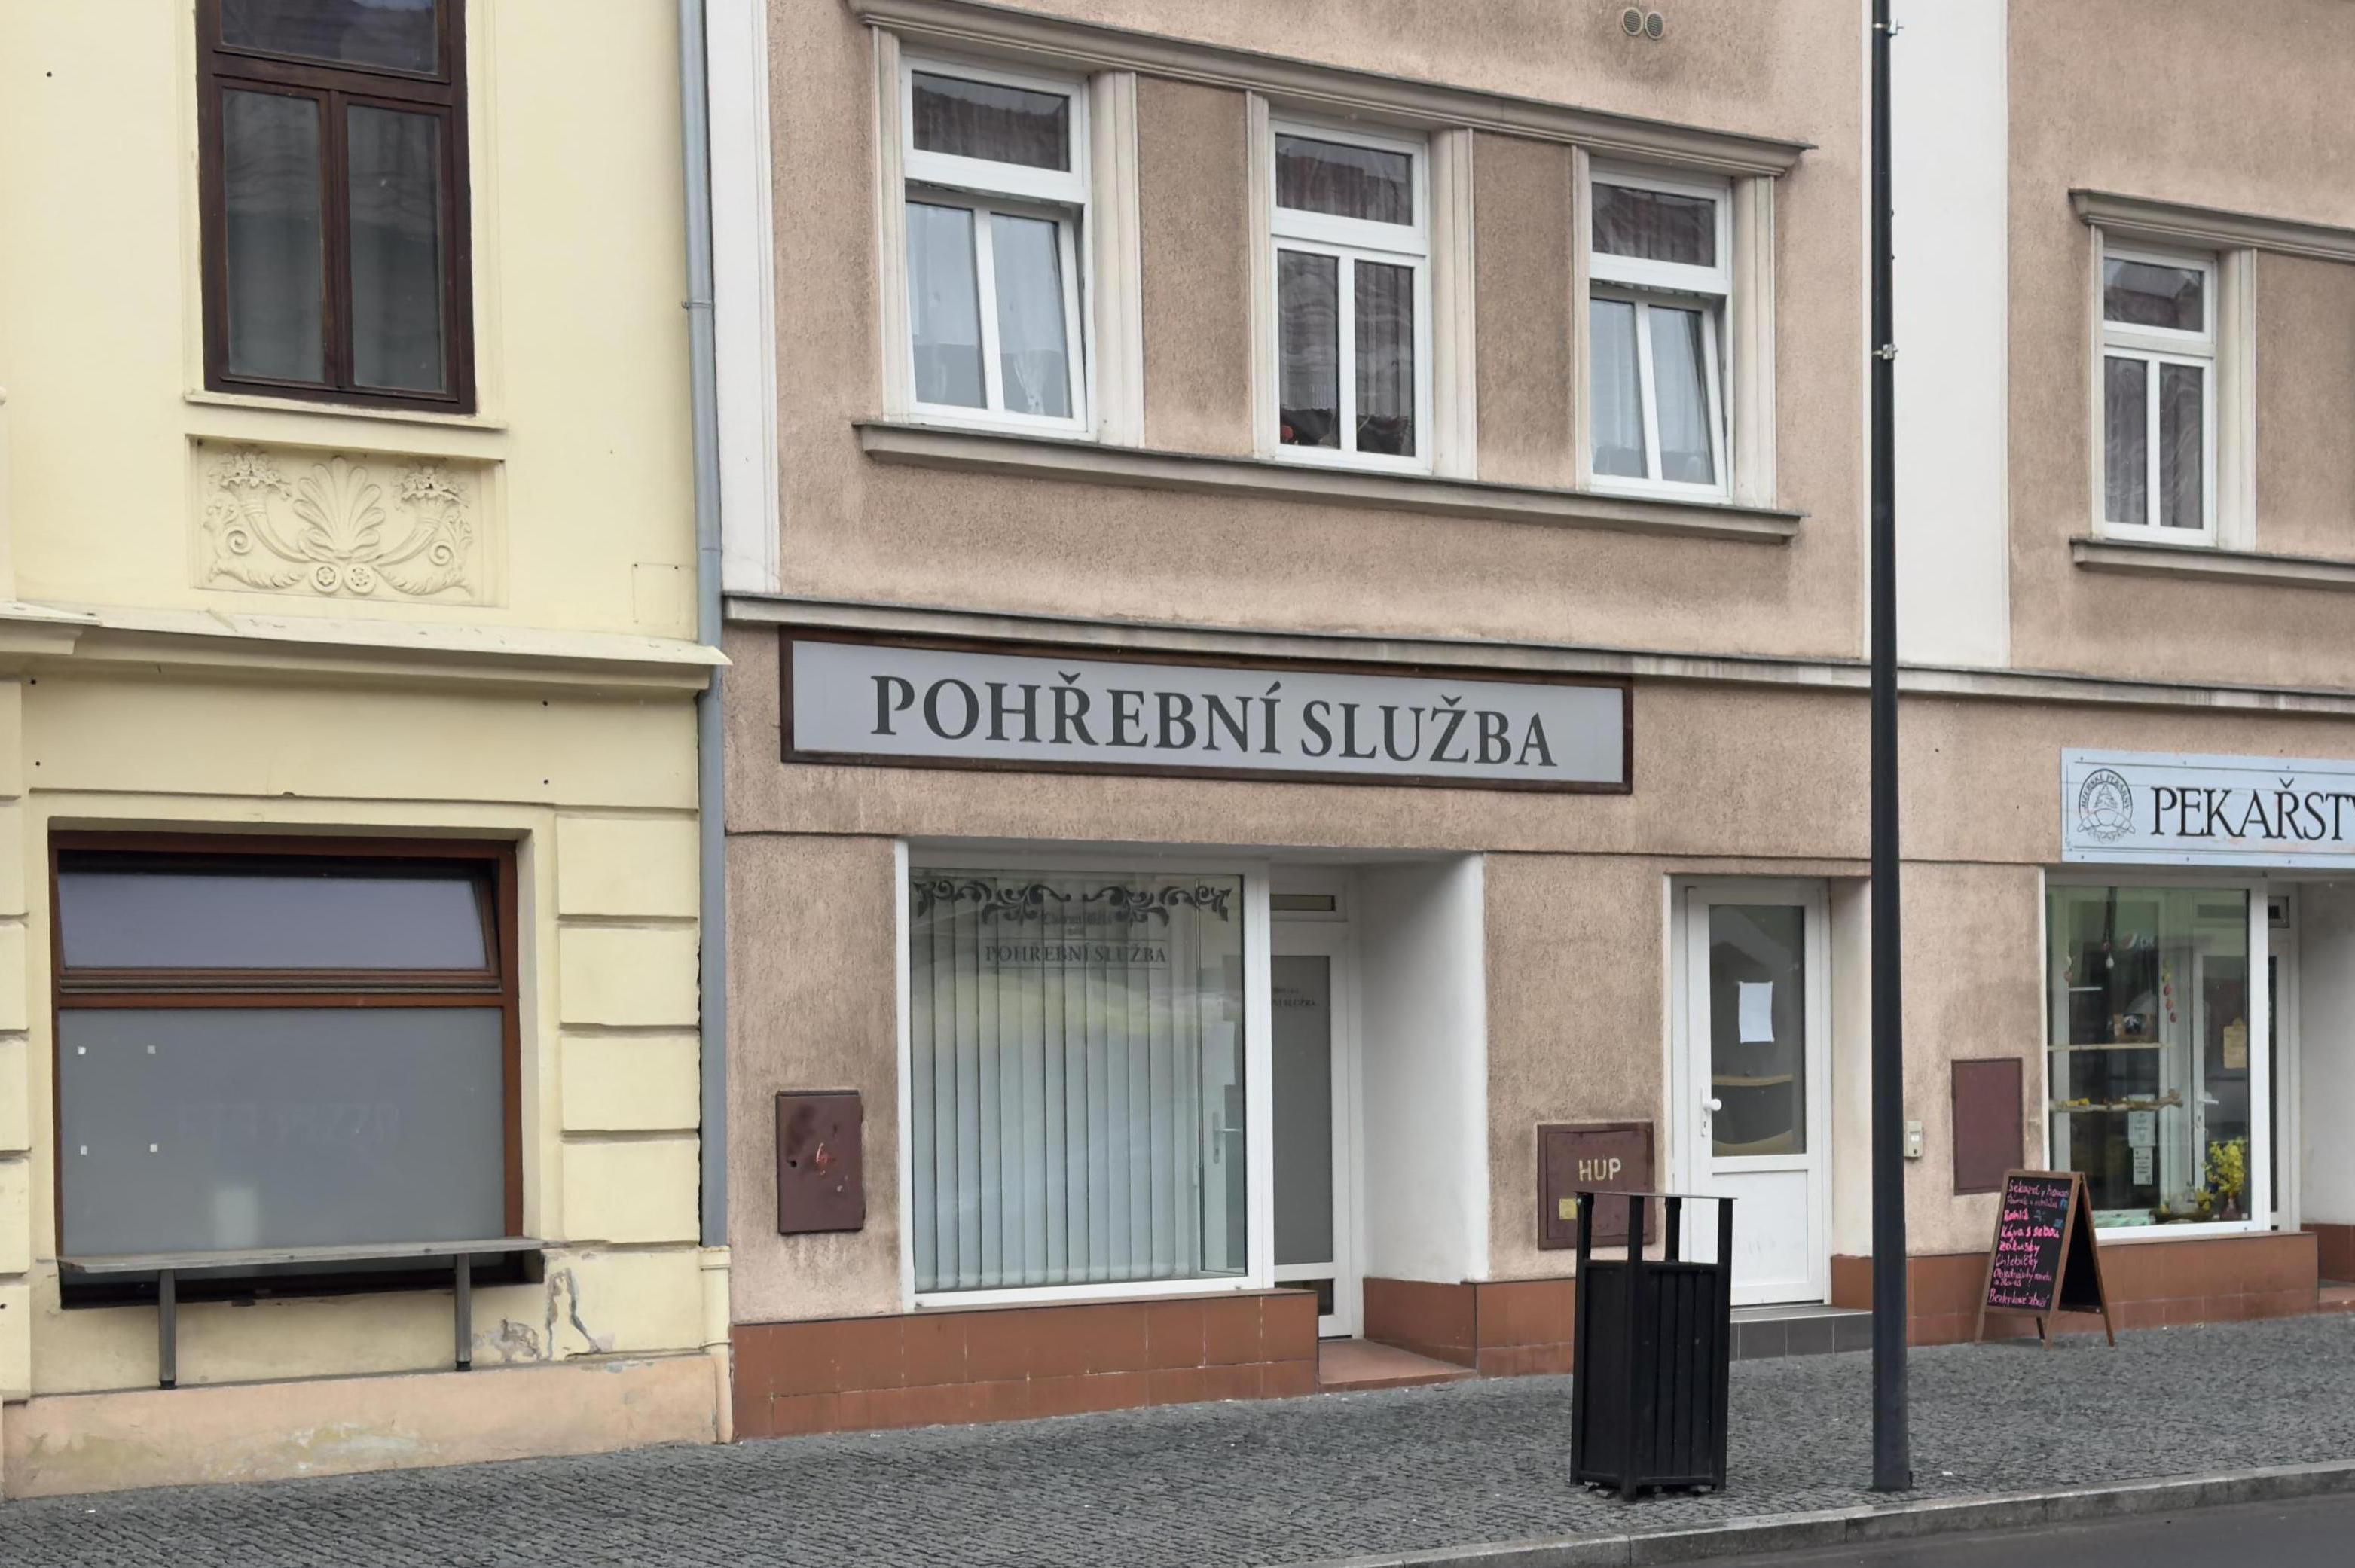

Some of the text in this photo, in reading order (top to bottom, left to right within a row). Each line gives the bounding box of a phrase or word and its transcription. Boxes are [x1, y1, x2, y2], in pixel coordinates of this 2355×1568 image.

[869, 672, 1558, 768] POHŘEBNÍ SLUŽBA
[2150, 776, 2355, 841] PEKAŘST
[984, 941, 1167, 964] POHŘEBNÍ SLUŽBA
[1578, 1158, 1622, 1182] HUP
